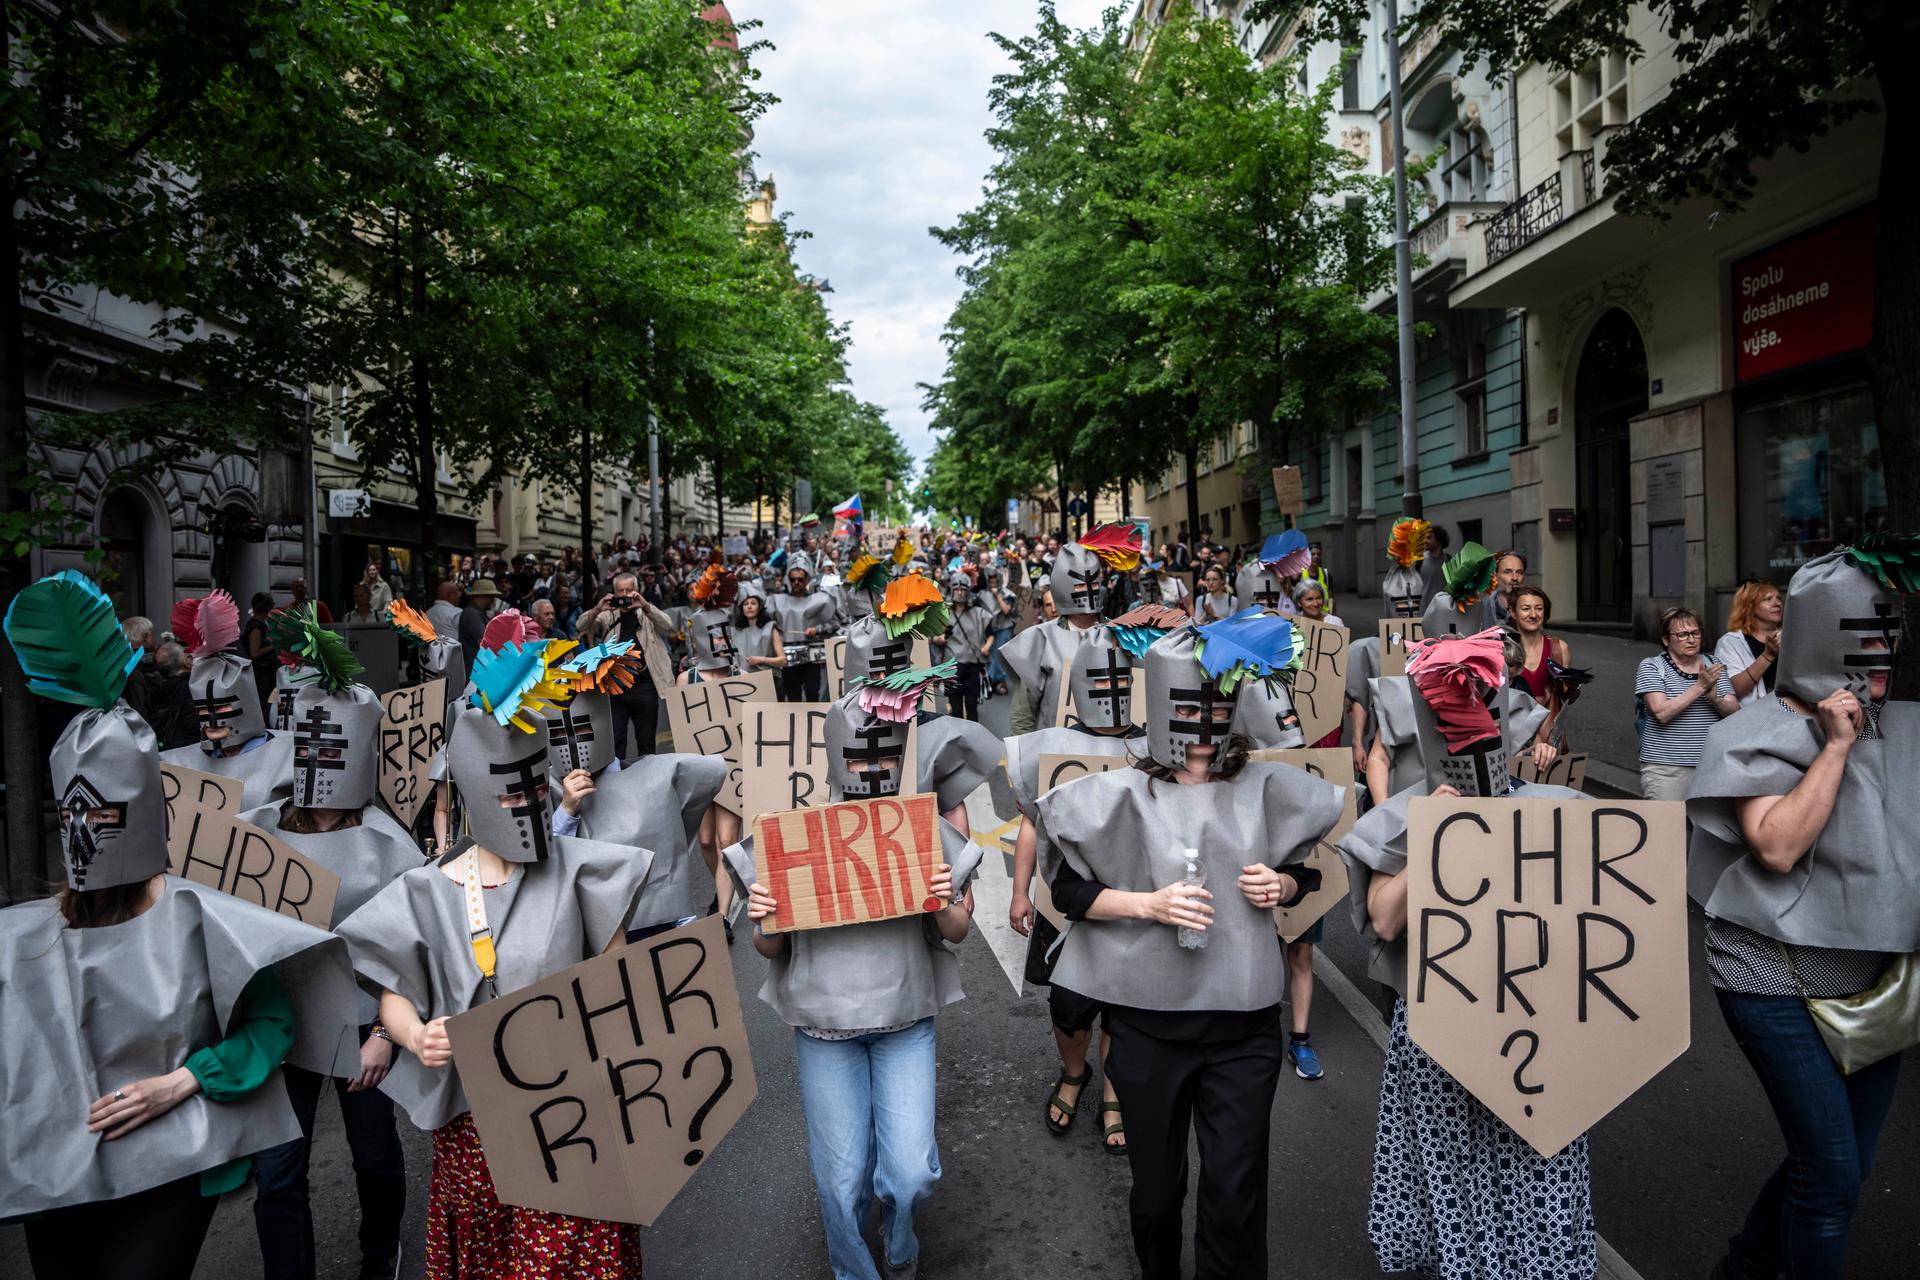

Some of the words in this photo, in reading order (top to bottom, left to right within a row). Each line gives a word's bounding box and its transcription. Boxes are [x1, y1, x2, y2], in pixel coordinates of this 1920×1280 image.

[1742, 265, 1785, 298] Spolu
[1743, 281, 1830, 326] dosáhneme
[1743, 328, 1783, 357] výše.
[382, 721, 445, 776] RRR
[388, 687, 425, 725] CH
[761, 797, 942, 929] HRR!
[1431, 806, 1657, 907] CHR
[1416, 907, 1640, 1023] RRR
[492, 936, 719, 1092] CHR
[530, 1045, 734, 1184] RR?
[1500, 1028, 1544, 1118] ?
